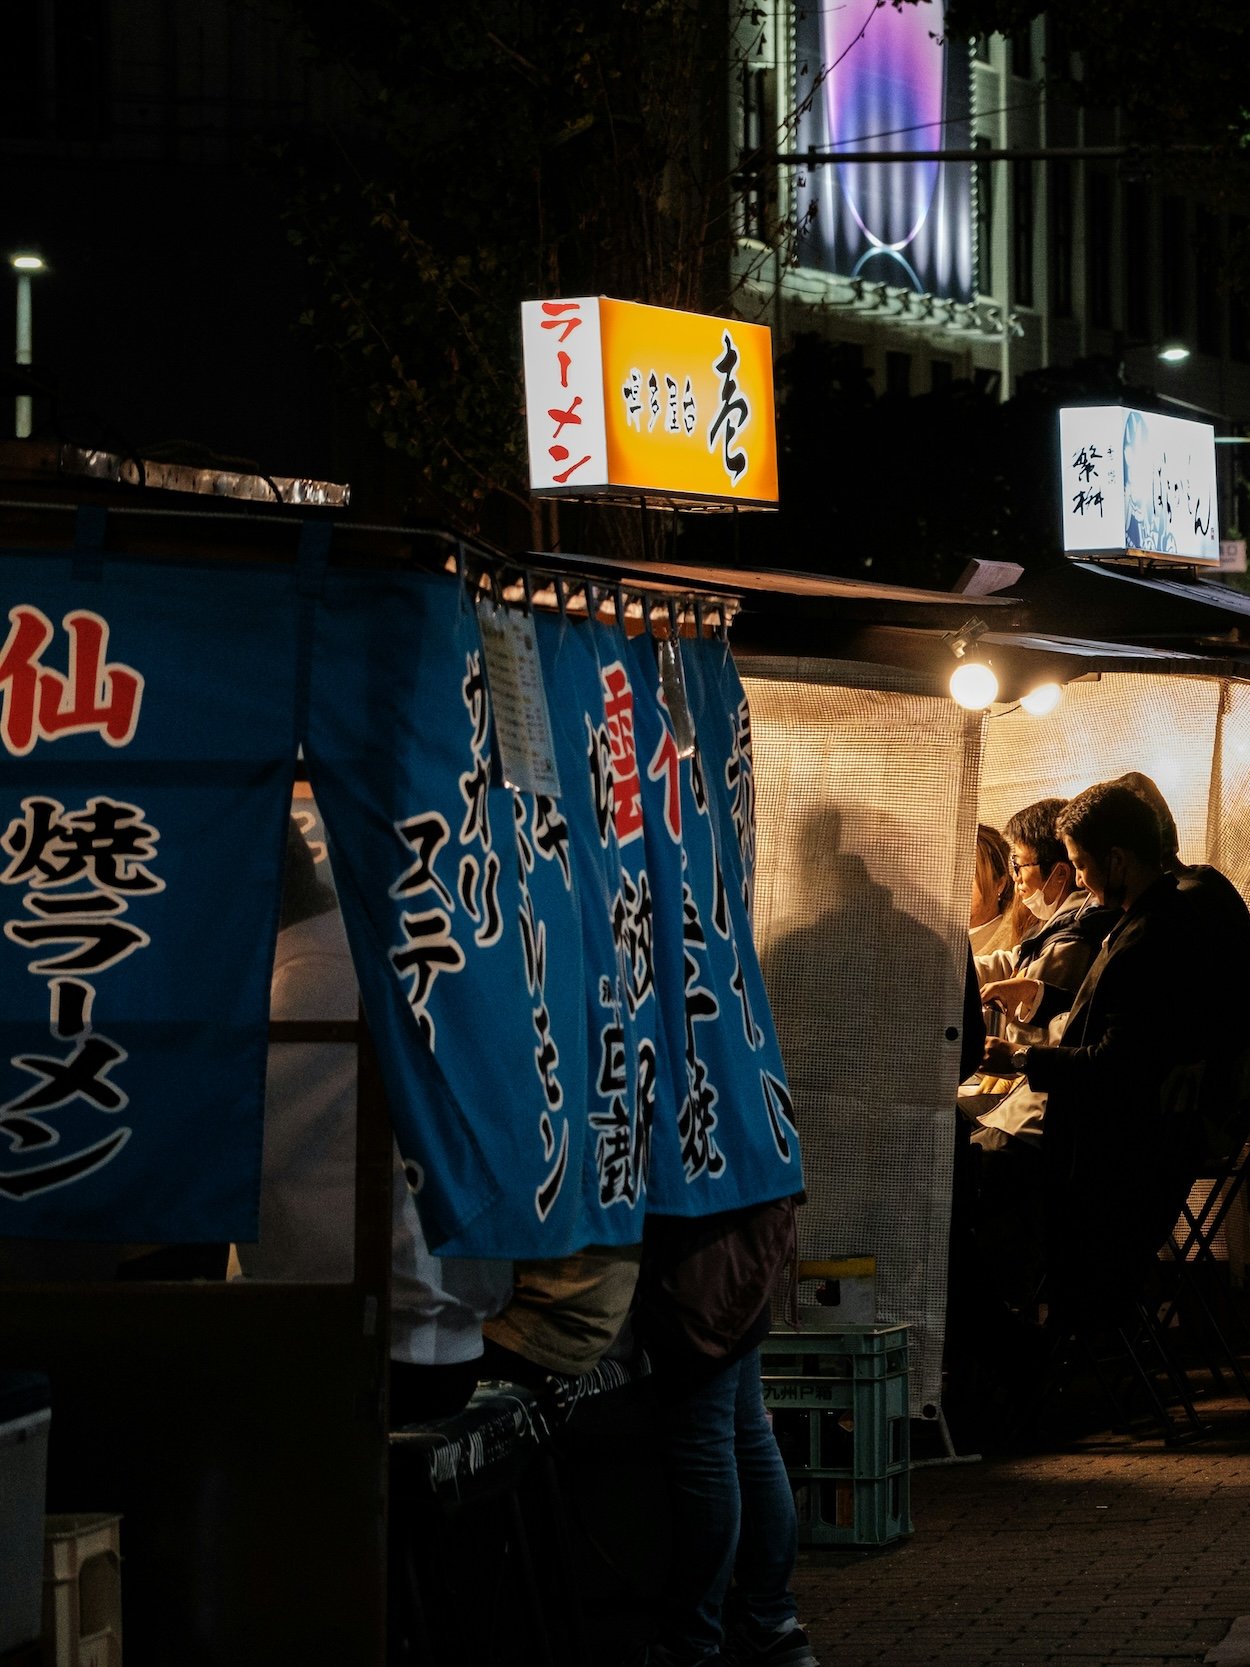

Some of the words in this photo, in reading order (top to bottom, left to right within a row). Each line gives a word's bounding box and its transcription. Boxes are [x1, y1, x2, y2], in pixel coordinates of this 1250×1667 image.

[540, 302, 592, 483] ラーメン
[0, 605, 144, 757] 仙
[0, 796, 166, 1200] 焼ラーメン
